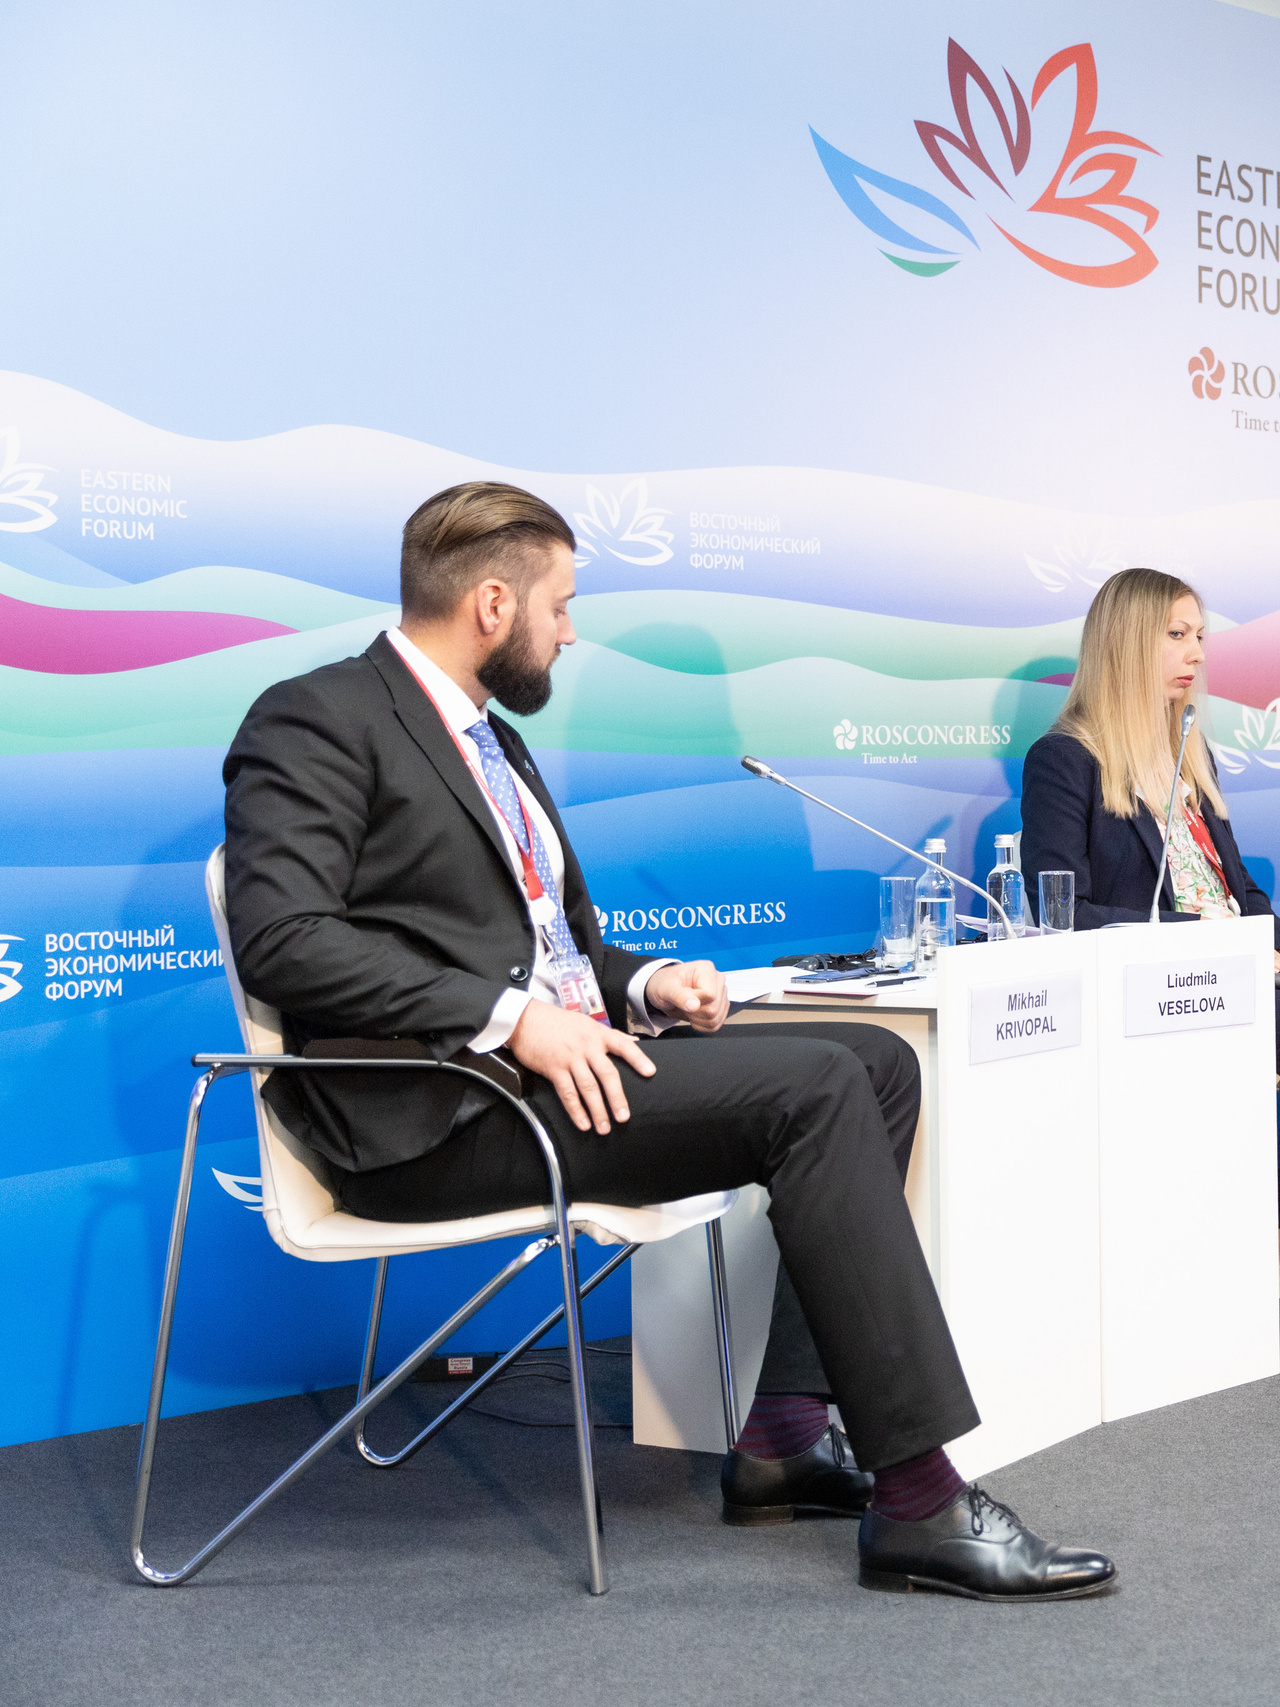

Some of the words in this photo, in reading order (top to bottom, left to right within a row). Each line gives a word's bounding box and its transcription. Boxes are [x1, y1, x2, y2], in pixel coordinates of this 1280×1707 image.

[1231, 410, 1270, 434] Time
[81, 468, 172, 494] EASTERN
[81, 492, 188, 519] ECONOMIC
[81, 517, 155, 540] FORUM
[689, 510, 781, 534] ВОСТОЧНЫЙ
[689, 530, 821, 556] ЭКОНОМИЧЕСКИЙ
[689, 551, 745, 571] ФОРУМ
[861, 724, 1012, 747] ROSCONGRESS
[861, 752, 887, 765] Time
[889, 754, 900, 765] to
[900, 752, 918, 765] Act
[611, 901, 787, 933] ROSCONGRESS
[45, 925, 175, 953] ВОСТОЧНЫЙ
[612, 939, 642, 951] Time
[644, 939, 656, 950] to
[658, 938, 678, 950] Act
[45, 978, 123, 1001] ФОРУМ
[1166, 969, 1218, 989] Liudmila
[1006, 989, 1048, 1012] Mikhail
[1158, 996, 1226, 1018] VESELOVA
[995, 1015, 1058, 1042] KRIVOPAL
